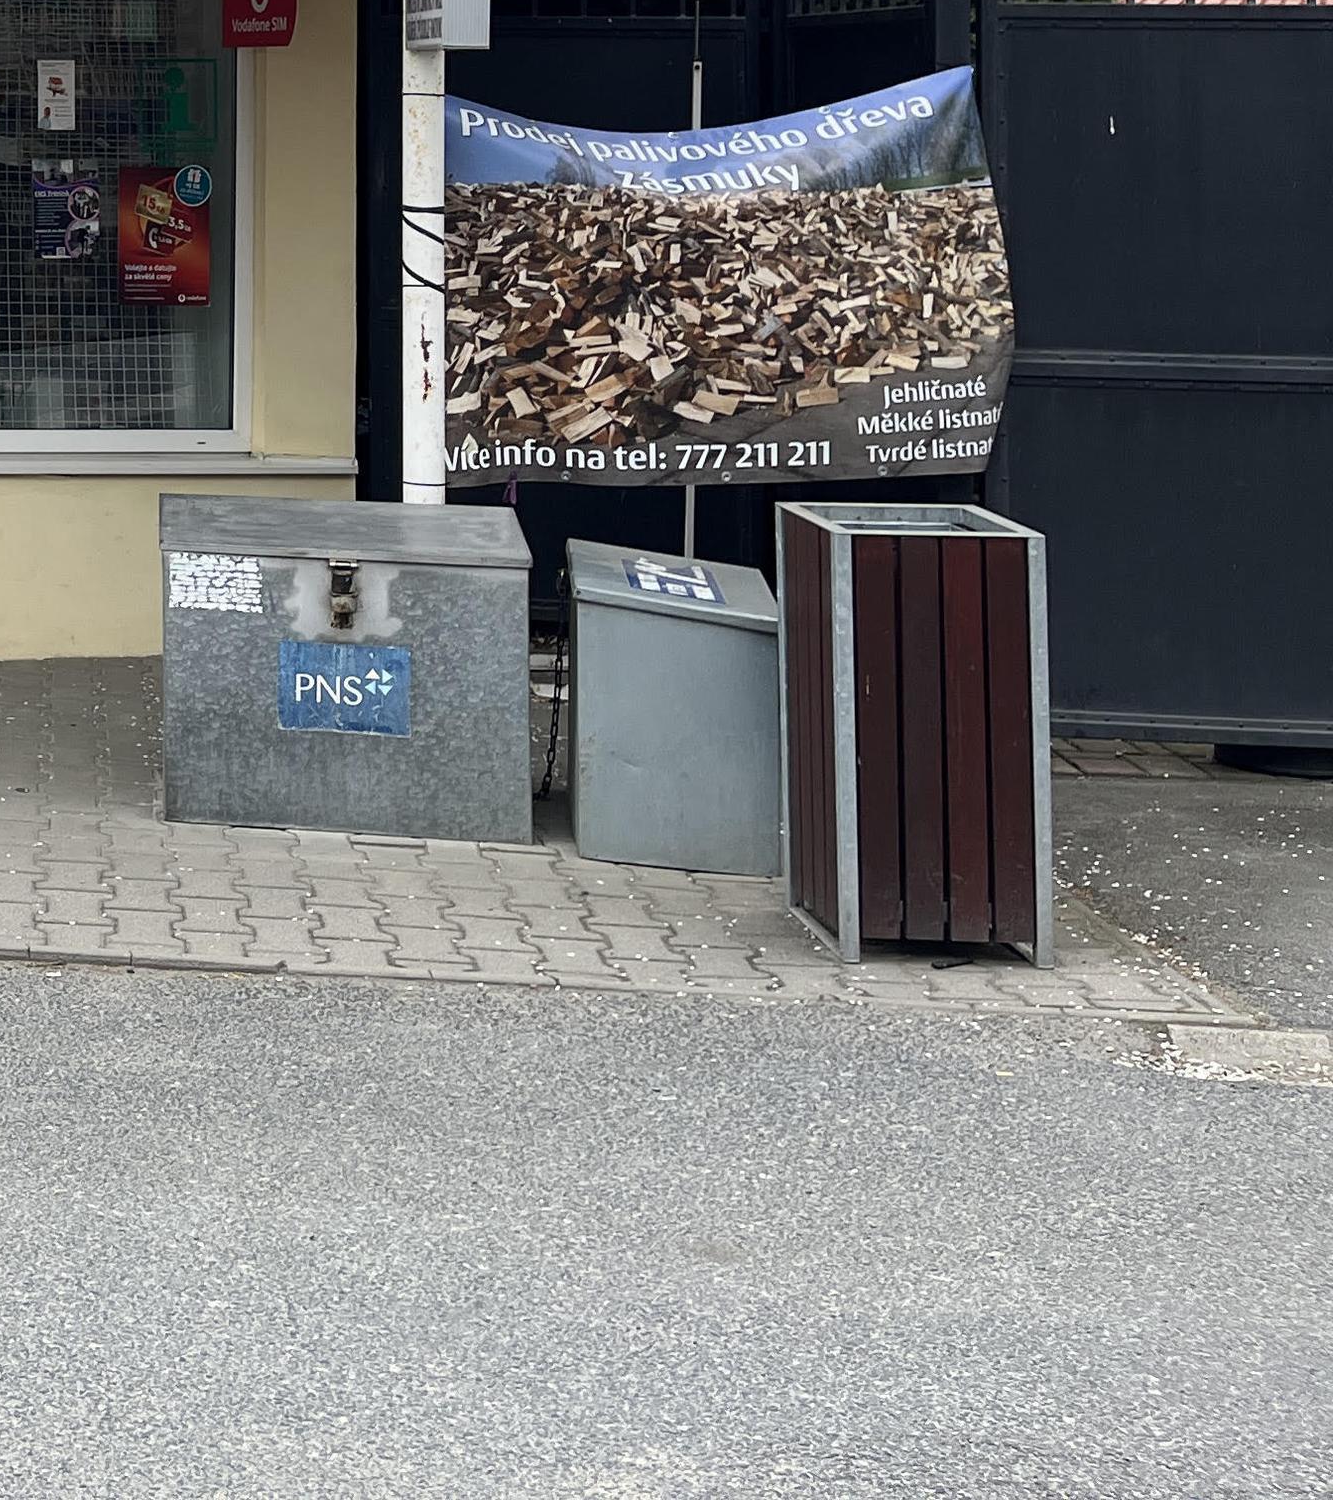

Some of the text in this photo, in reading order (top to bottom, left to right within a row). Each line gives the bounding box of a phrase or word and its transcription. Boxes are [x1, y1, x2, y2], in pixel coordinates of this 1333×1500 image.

[232, 16, 287, 33] Vodafone SIM
[459, 95, 934, 163] Prodej palivového dřeva
[612, 161, 800, 195] Zásmuky
[167, 216, 185, 230] 3,5
[884, 374, 987, 409] Jehličnaté
[857, 409, 933, 436] Měkké
[444, 438, 831, 472] Více info na tel: 777 211 211
[865, 435, 994, 463] Tvrdé listnat
[294, 672, 364, 706] PNS
